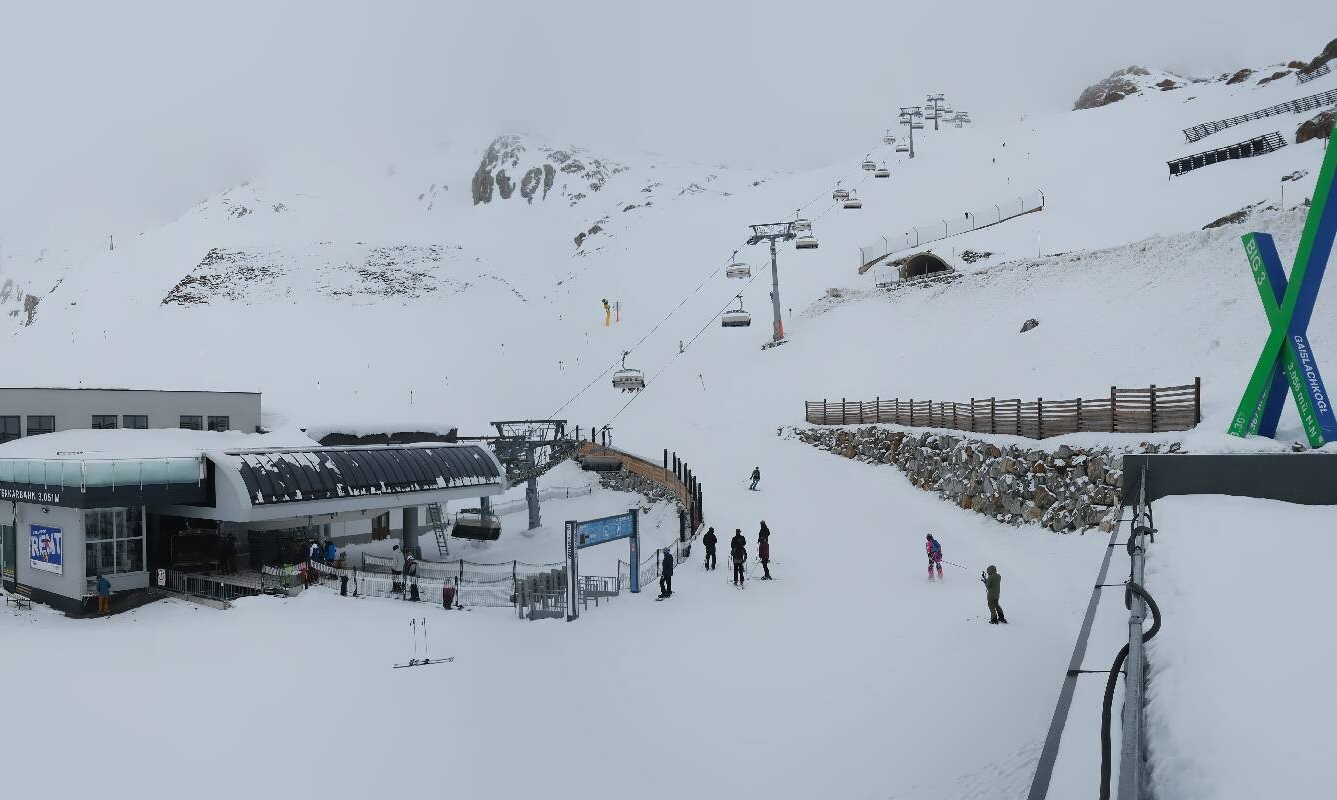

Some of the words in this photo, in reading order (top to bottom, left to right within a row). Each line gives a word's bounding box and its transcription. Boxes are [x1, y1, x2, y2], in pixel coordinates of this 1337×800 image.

[1247, 239, 1261, 271] BIG
[1257, 271, 1266, 286] 3
[1294, 335, 1327, 415] GAISLACHKOGL
